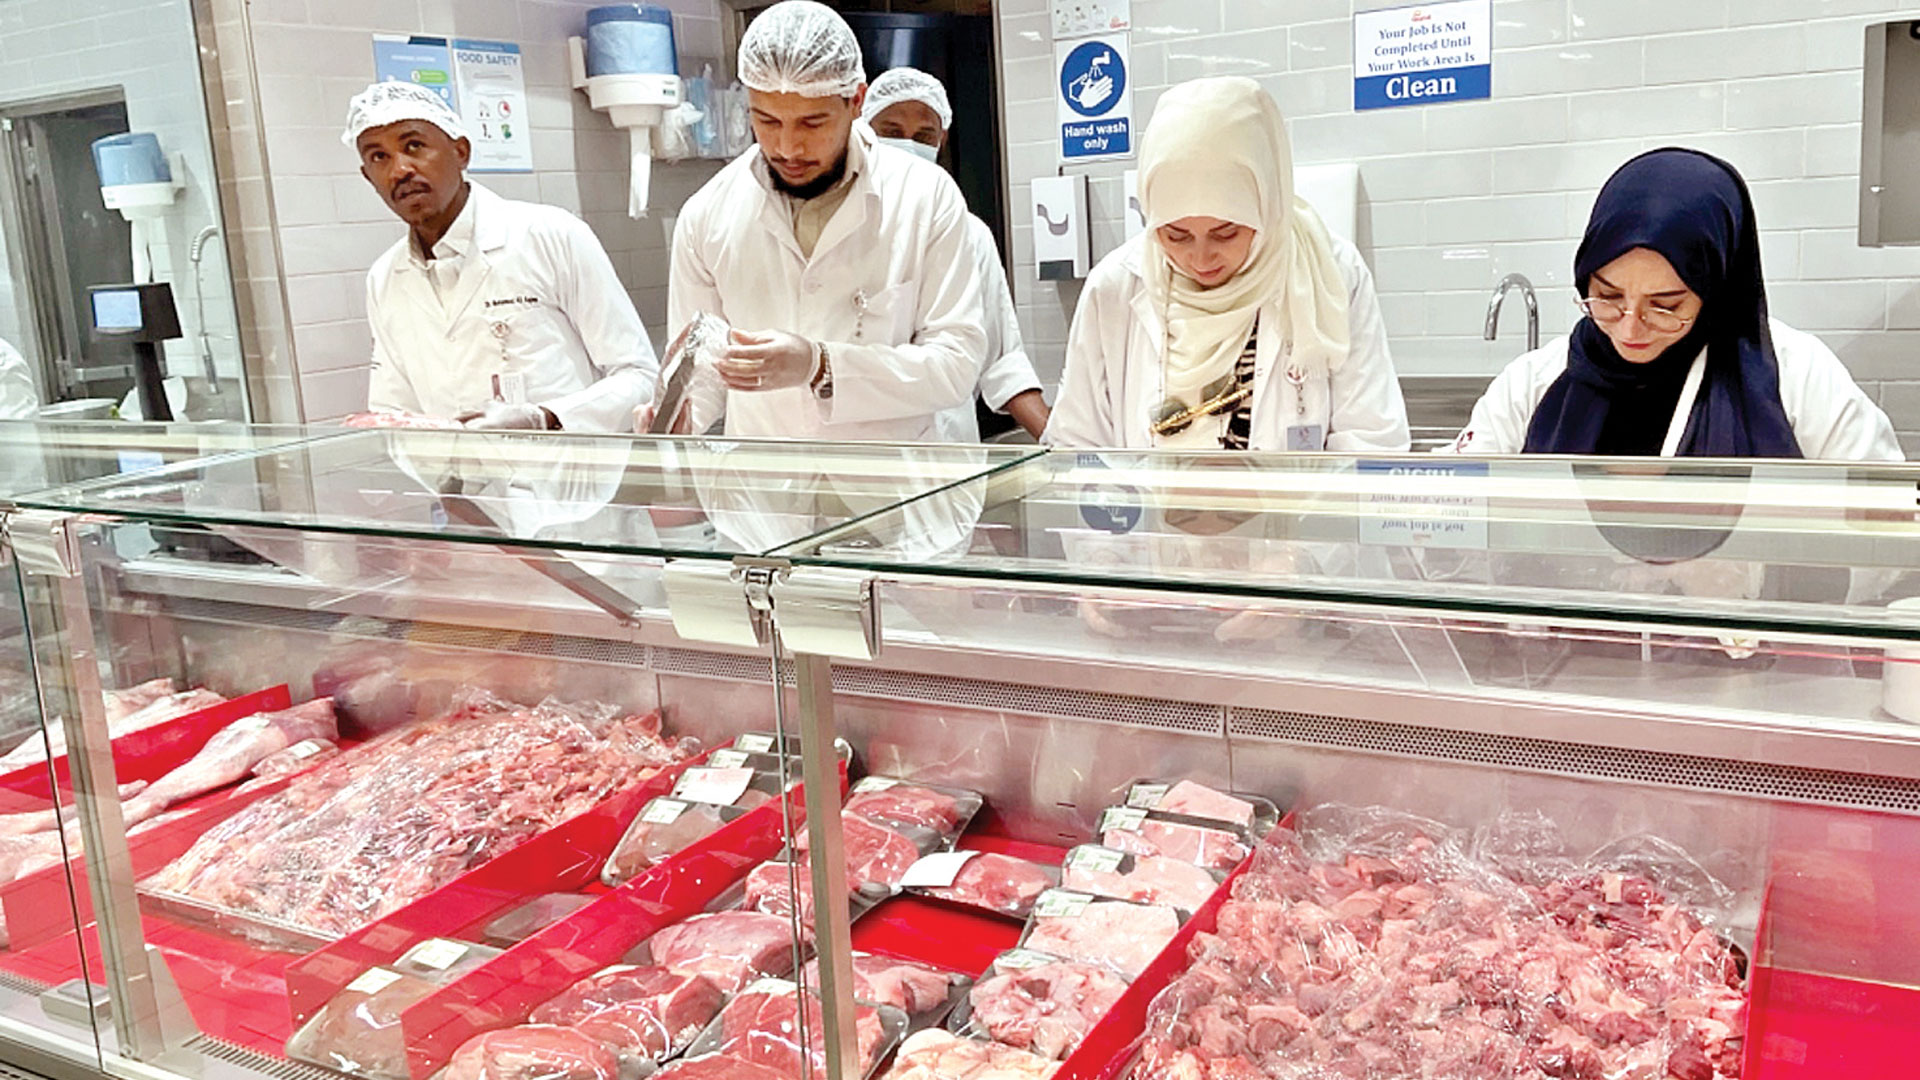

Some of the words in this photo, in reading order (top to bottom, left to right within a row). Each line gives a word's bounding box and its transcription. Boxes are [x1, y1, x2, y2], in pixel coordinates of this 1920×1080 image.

[1379, 28, 1406, 40] Your
[1409, 25, 1429, 38] Job
[1432, 23, 1442, 33] Is
[1445, 21, 1466, 32] Not
[1374, 40, 1438, 56] Completed
[1441, 36, 1471, 49] Until
[457, 52, 483, 64] FOOD
[486, 54, 518, 66] SAFETY
[1368, 61, 1394, 73] Your
[1397, 56, 1431, 69] Work
[1433, 55, 1461, 66] Area
[1465, 52, 1475, 62] Is
[1385, 76, 1456, 100] Clean
[1064, 124, 1094, 137] Hand
[1096, 121, 1127, 134] wash
[1083, 137, 1109, 150] only
